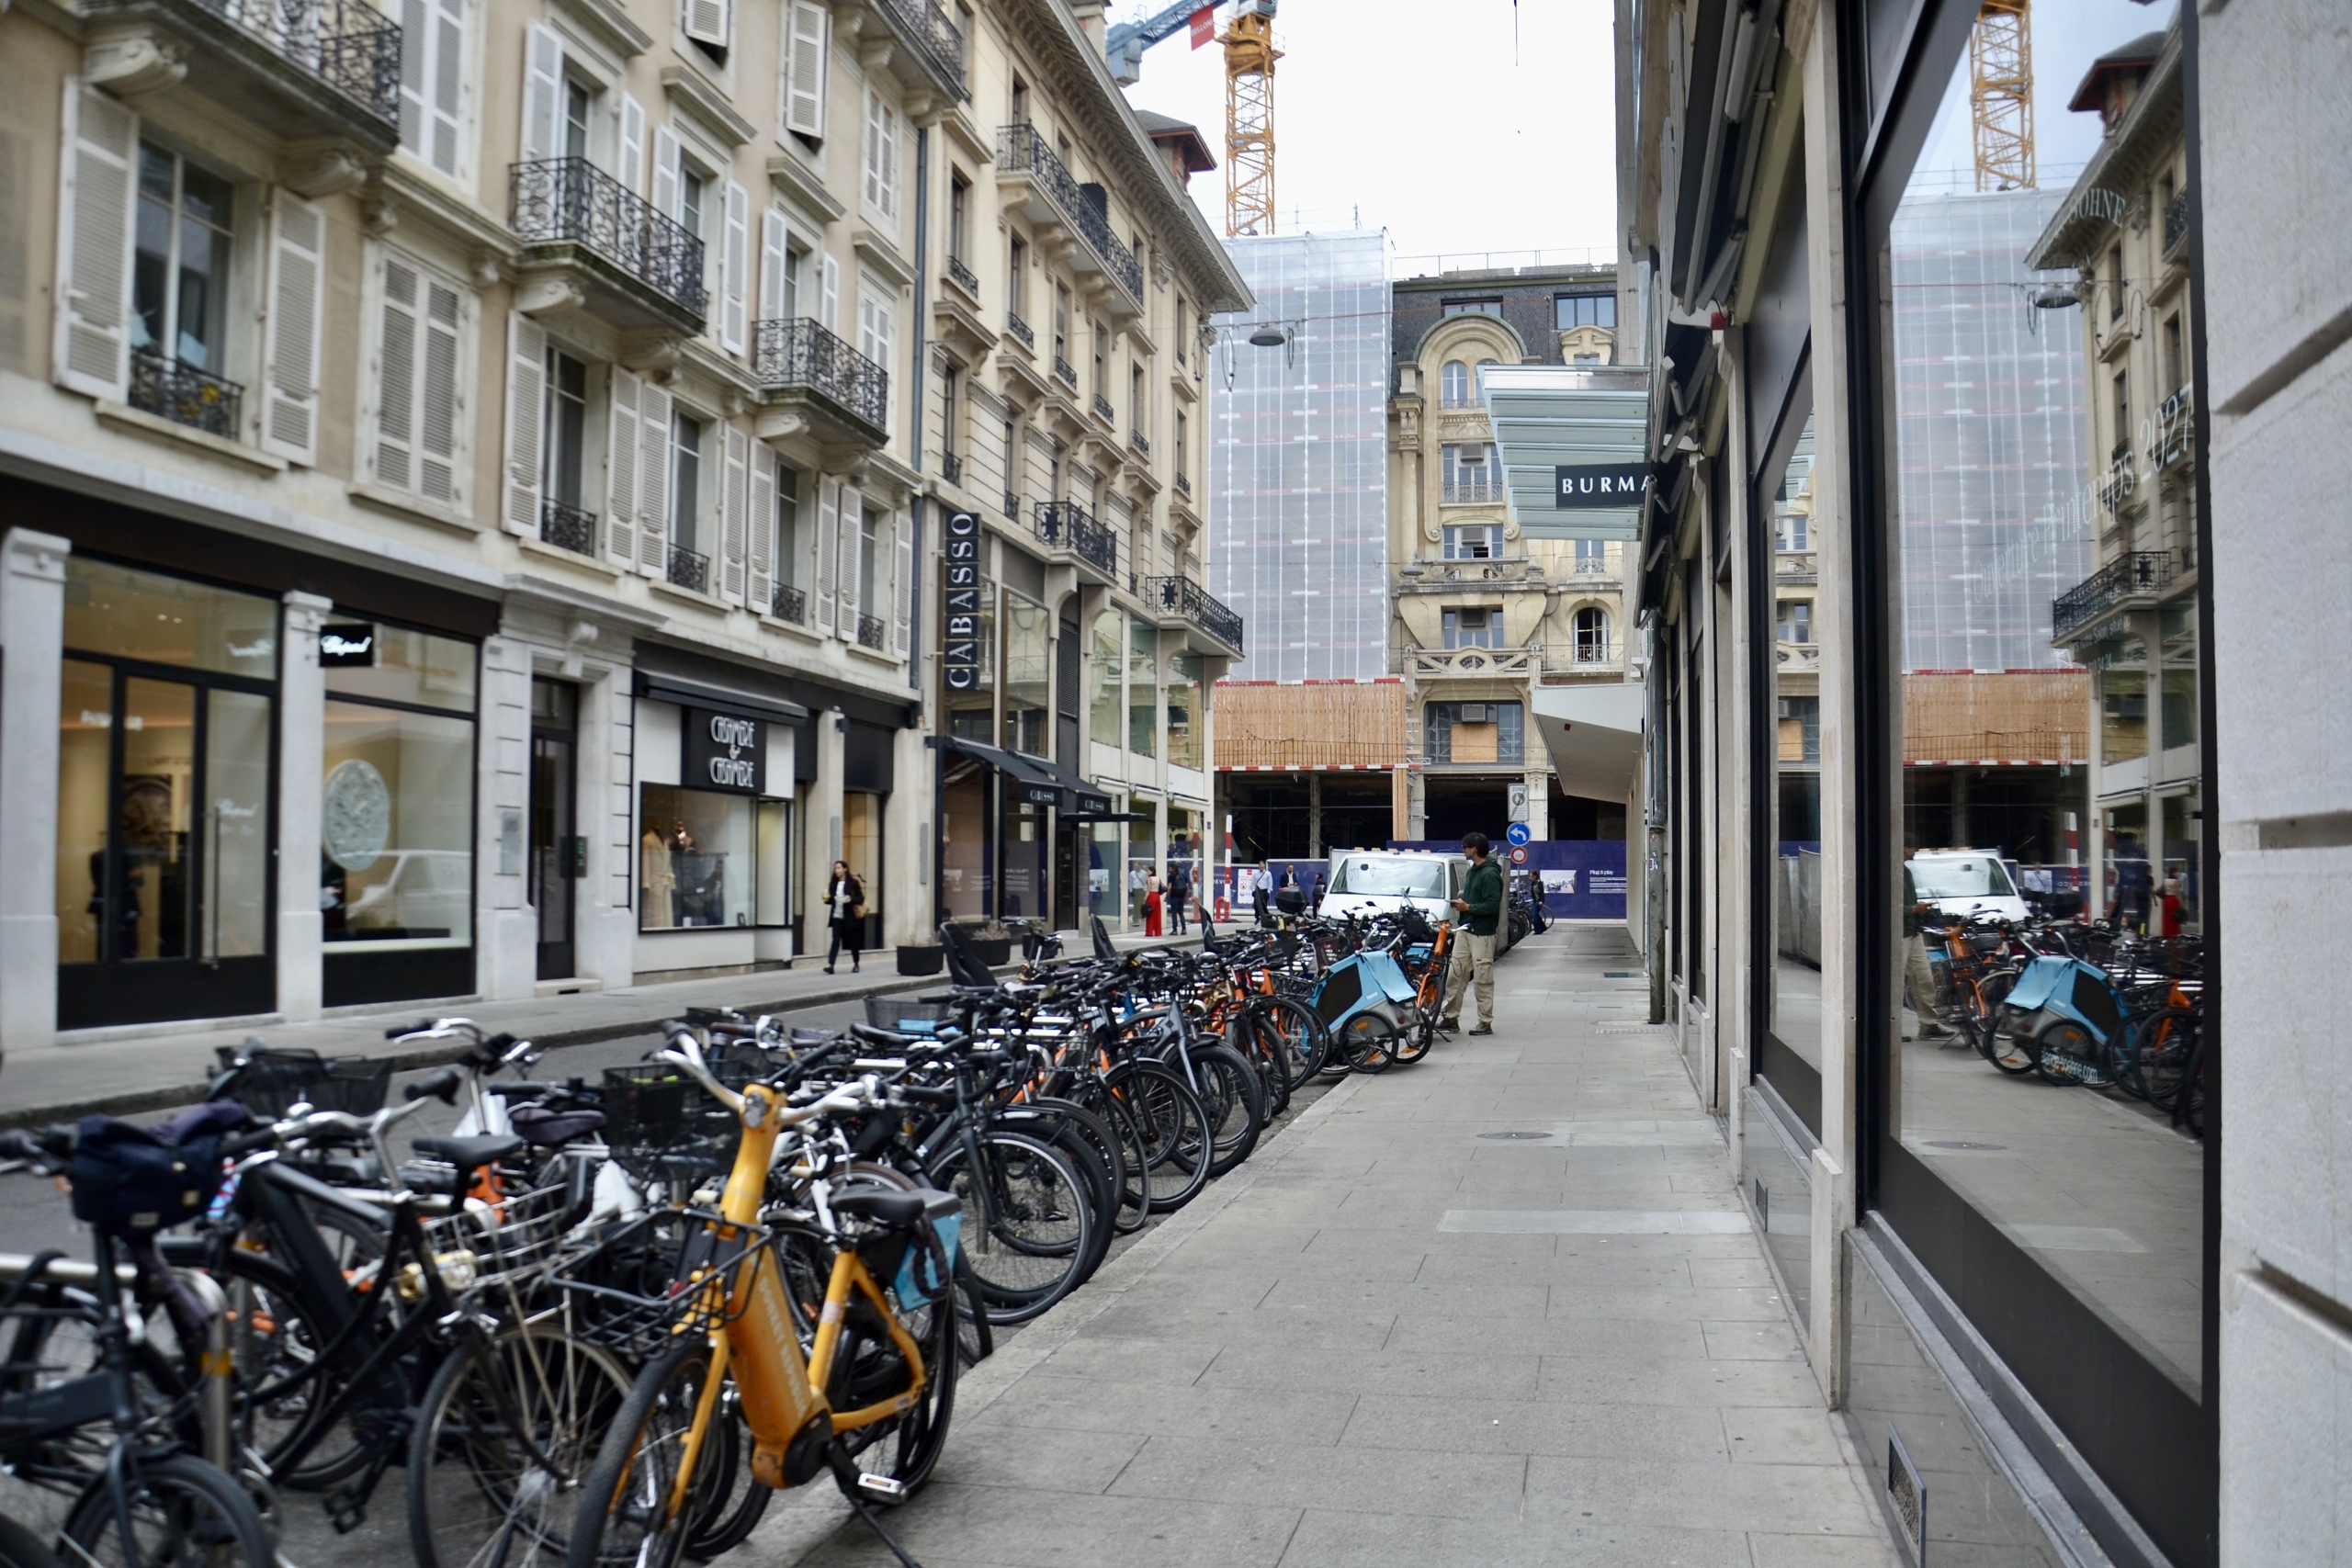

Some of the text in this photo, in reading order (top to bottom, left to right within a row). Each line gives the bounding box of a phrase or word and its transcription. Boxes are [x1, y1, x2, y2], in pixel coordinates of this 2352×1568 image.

[1973, 380, 2193, 604] Ouverture Printemps 2027
[948, 513, 975, 688] CABASSO
[709, 757, 754, 788] CASHMERE
[710, 716, 755, 749] CASHMERE
